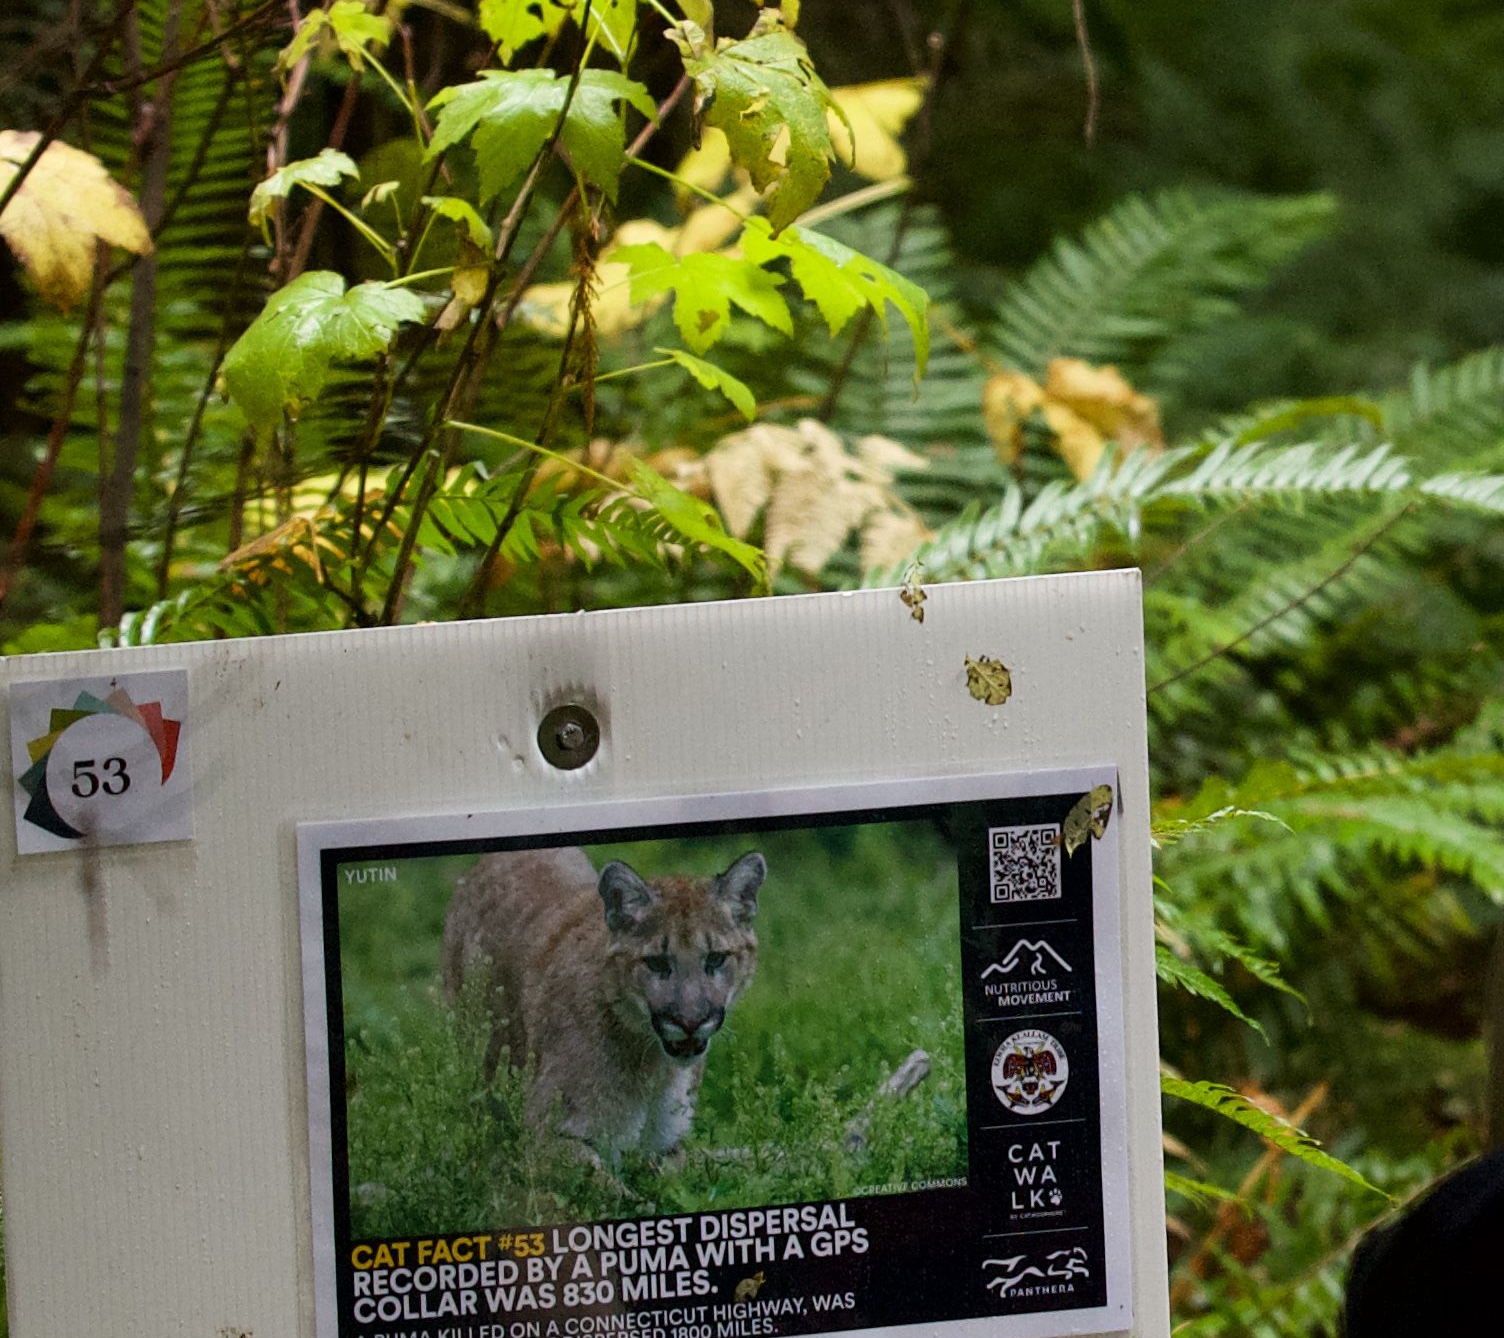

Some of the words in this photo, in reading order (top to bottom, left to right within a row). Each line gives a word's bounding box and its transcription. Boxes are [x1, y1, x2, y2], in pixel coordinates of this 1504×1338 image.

[71, 757, 131, 798] 53
[344, 866, 397, 885] YUTIN
[984, 979, 1058, 996] NUTRITIOUS
[998, 990, 1071, 1007] MOVEMENT
[1008, 1140, 1061, 1163] CAT
[911, 1176, 968, 1191] COMMONS
[1013, 1164, 1057, 1186] WA
[1011, 1188, 1045, 1210] LK
[351, 1241, 410, 1270] CAT
[418, 1236, 492, 1265] FACT
[498, 1232, 545, 1258] #53
[552, 1217, 693, 1254] LONGEST
[700, 1203, 856, 1242] DISPERSAL
[353, 1260, 519, 1297] RECORDED
[527, 1255, 563, 1283] BY
[571, 1253, 593, 1279] A
[600, 1245, 689, 1276] PUMA
[696, 1235, 775, 1267] WITH
[783, 1234, 804, 1260] A
[810, 1227, 869, 1257] GPS
[353, 1290, 478, 1324] COLLAR
[485, 1284, 556, 1313] WAS
[563, 1280, 614, 1307] 830
[622, 1269, 719, 1302] MILES.
[1009, 1283, 1075, 1298] PANTHERA
[510, 1321, 540, 1338] ON
[546, 1320, 560, 1336] A
[564, 1305, 708, 1336] CONNECTICUT
[713, 1297, 808, 1322] HIGHWAY,
[812, 1291, 856, 1312] WAS
[717, 1318, 779, 1338] MILES.
